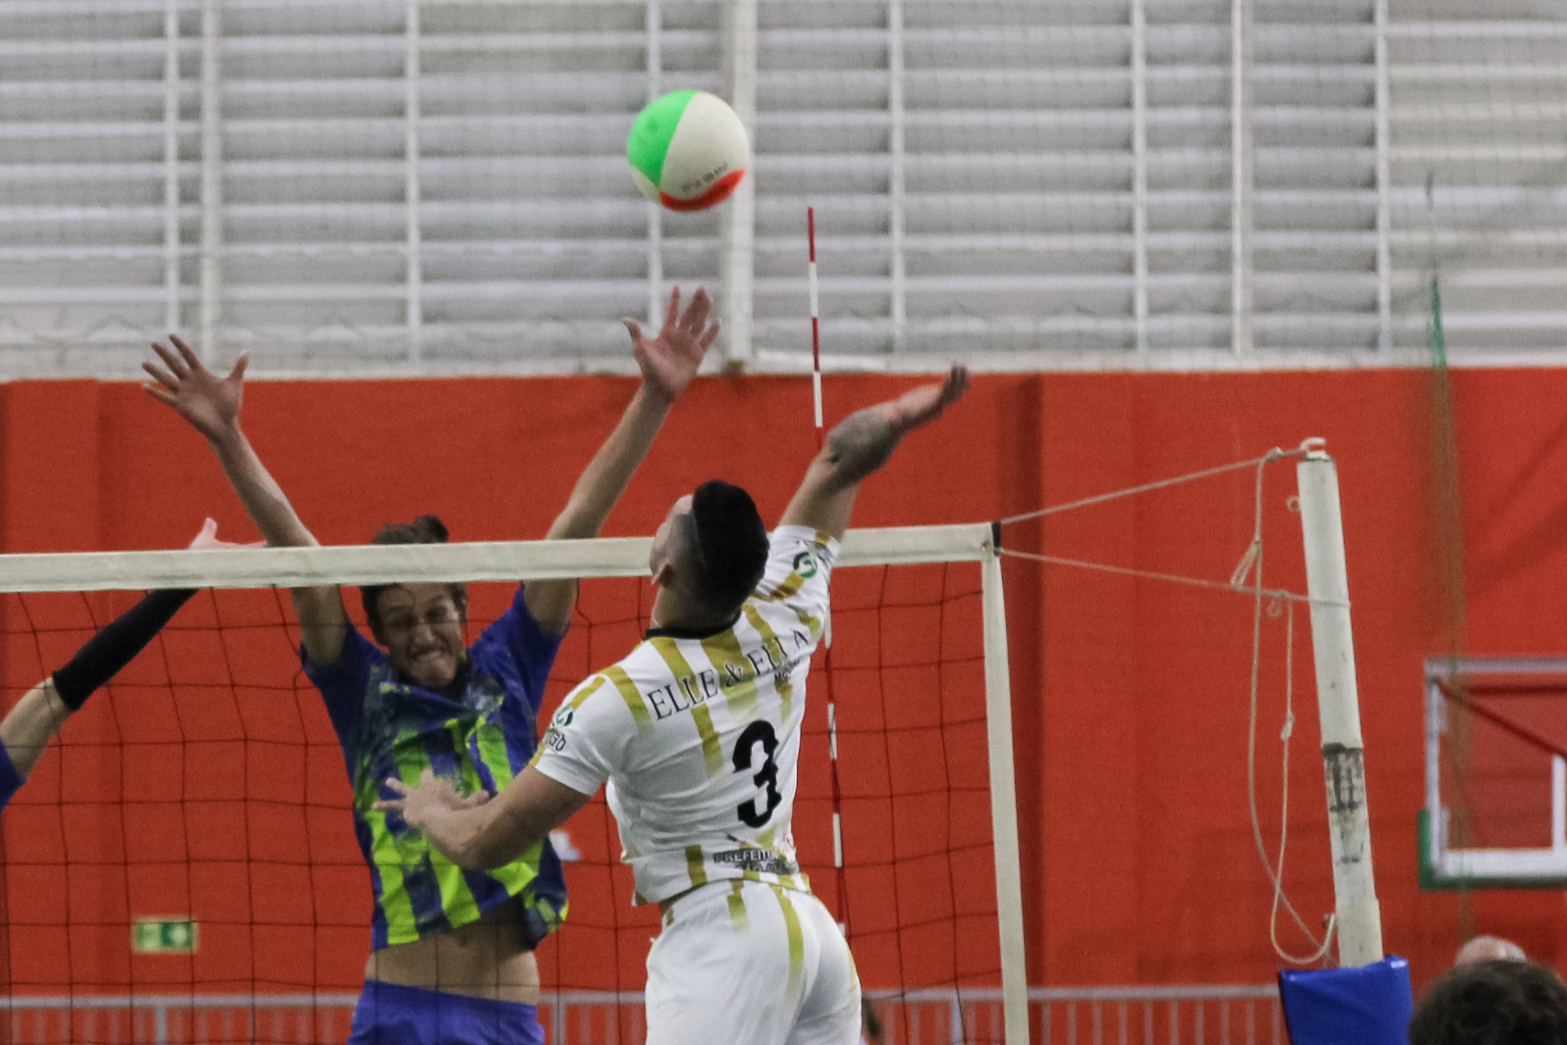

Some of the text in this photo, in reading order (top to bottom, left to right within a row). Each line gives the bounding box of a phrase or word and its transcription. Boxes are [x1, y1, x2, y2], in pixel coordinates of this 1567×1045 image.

[647, 668, 719, 720] ELLE
[725, 663, 744, 687] &
[733, 720, 782, 828] 3
